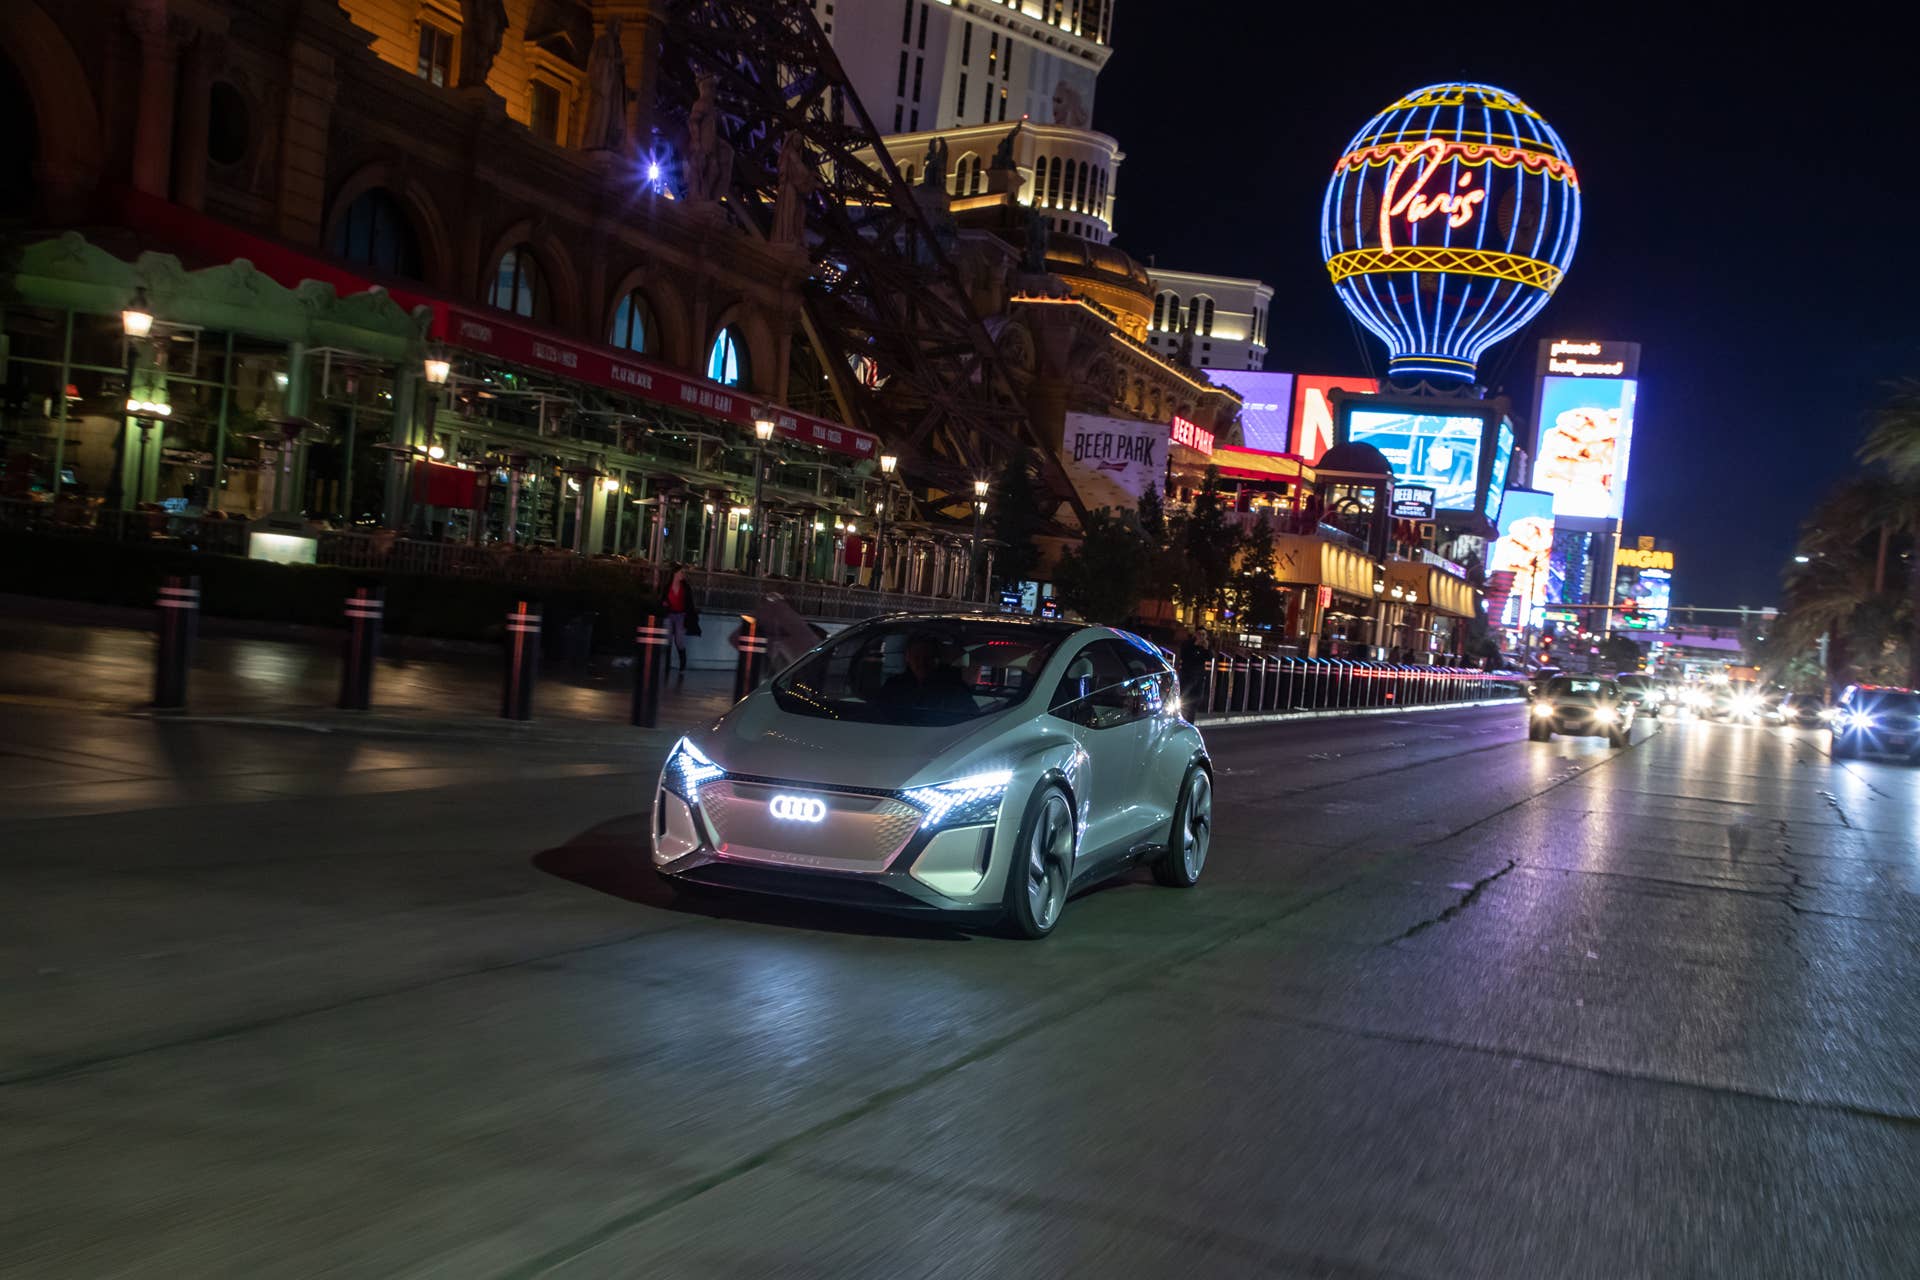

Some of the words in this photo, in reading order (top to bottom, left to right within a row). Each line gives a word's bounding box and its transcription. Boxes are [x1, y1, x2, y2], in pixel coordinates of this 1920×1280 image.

[1379, 137, 1486, 255] Paris
[1550, 340, 1601, 357] planet
[1549, 358, 1624, 376] hollywood
[1172, 415, 1195, 447] BEER
[1193, 427, 1215, 456] PARK
[1074, 433, 1113, 462] BEER
[1117, 434, 1157, 466] PARK
[1393, 488, 1413, 502] BEER
[1413, 488, 1433, 505] PARK
[1616, 549, 1674, 570] MGM
